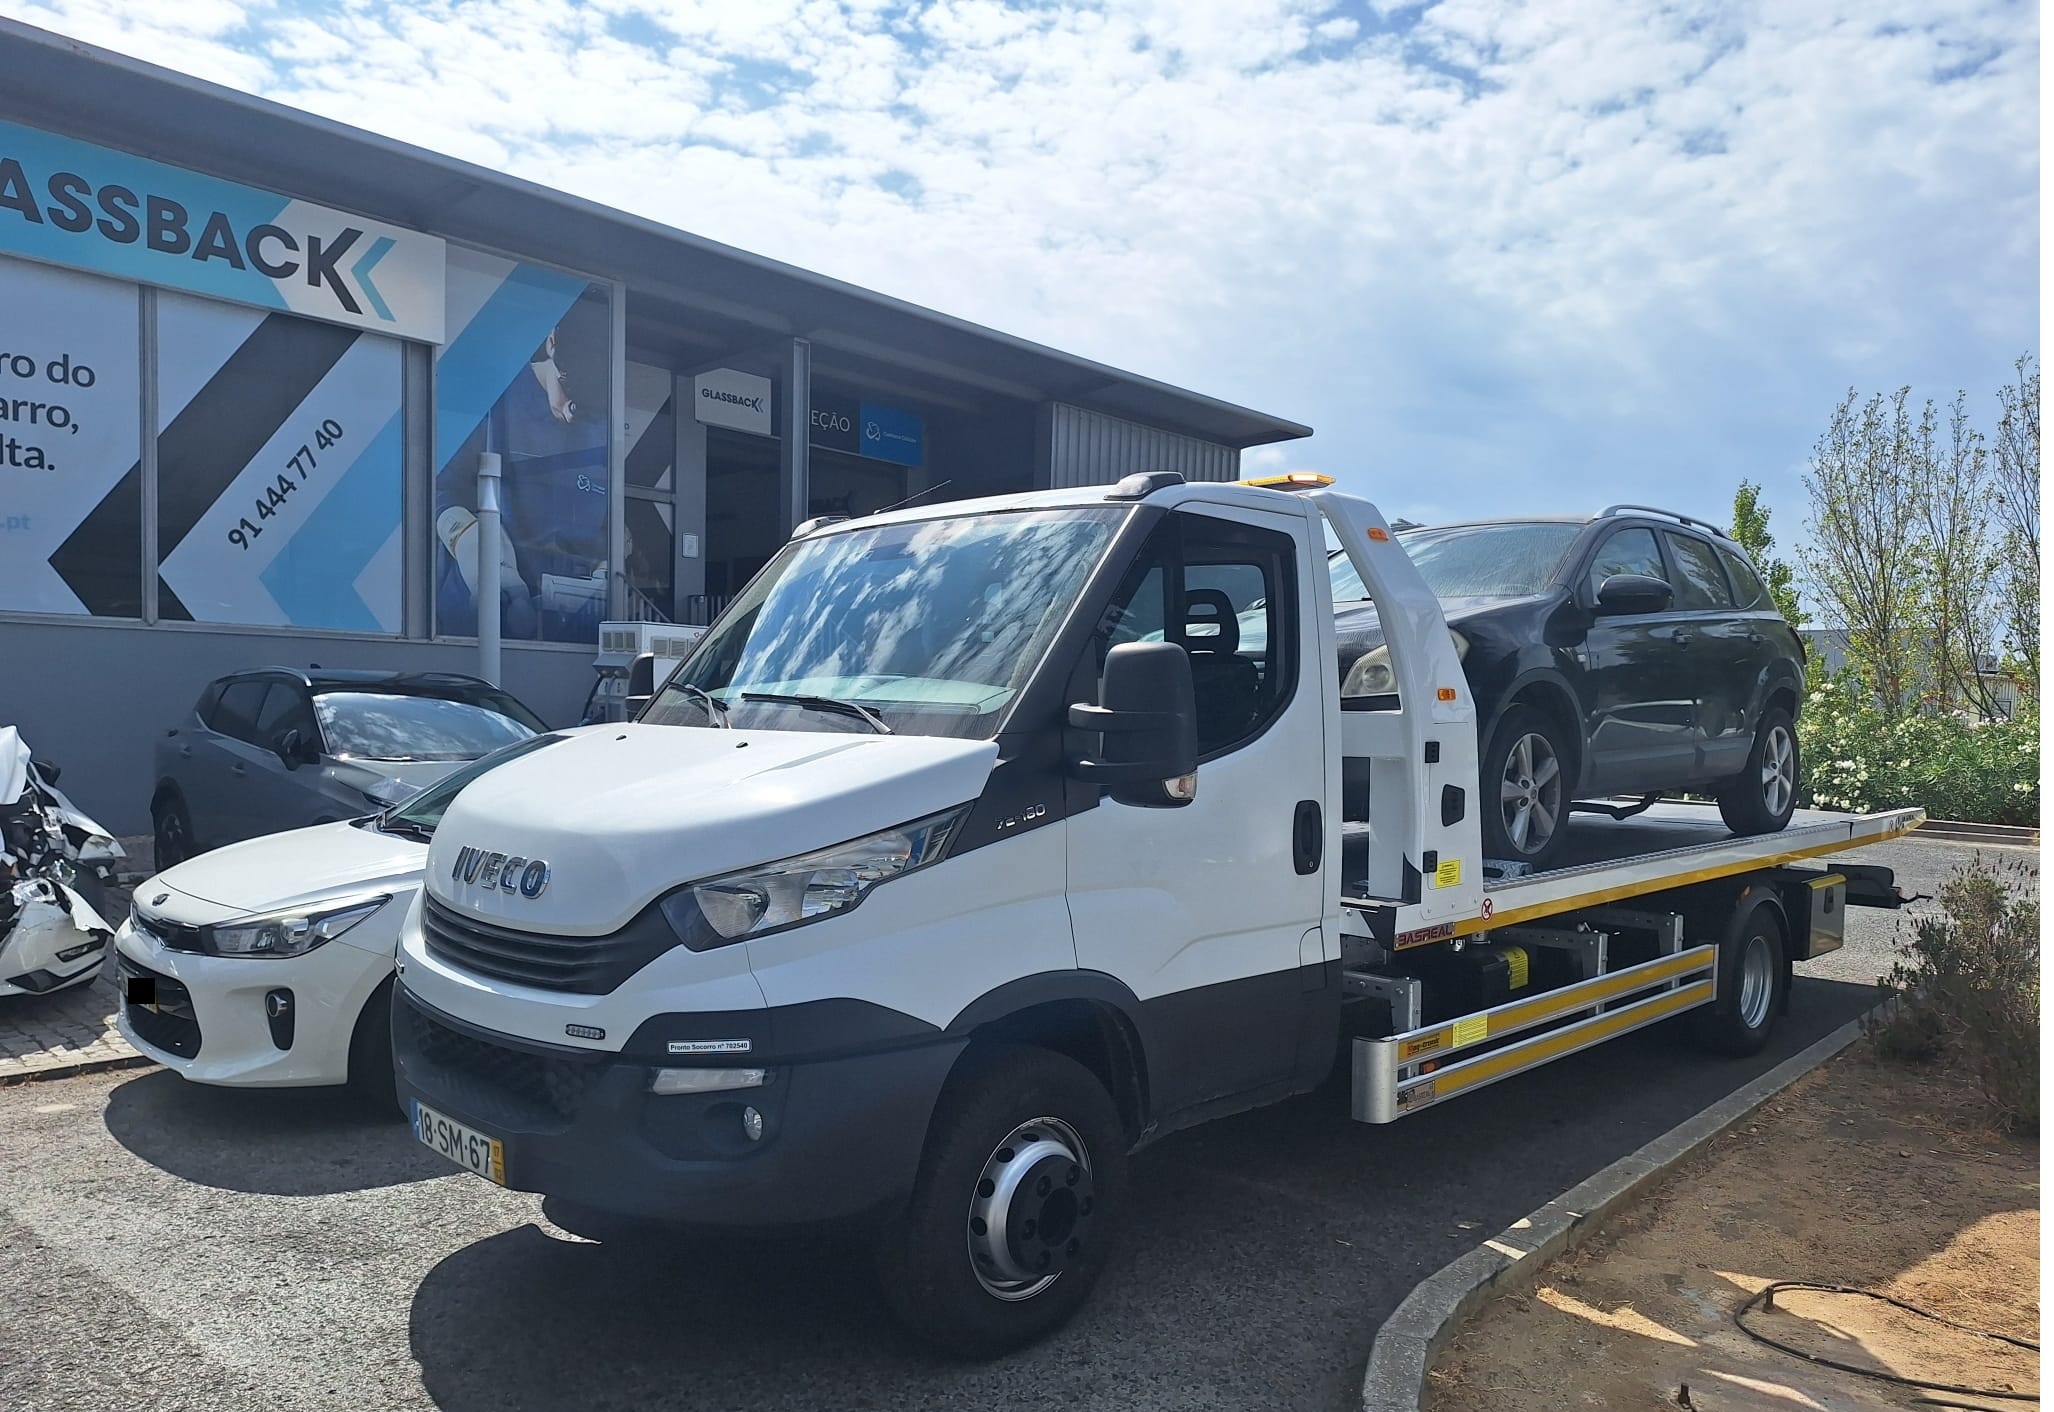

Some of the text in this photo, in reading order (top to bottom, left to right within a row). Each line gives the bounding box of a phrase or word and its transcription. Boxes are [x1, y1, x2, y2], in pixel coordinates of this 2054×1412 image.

[46, 353, 96, 388] do
[701, 388, 760, 413] GLASSBACK
[228, 419, 344, 551] 91 444 77 40
[452, 845, 552, 900] IVECO
[670, 1044, 691, 1052] Pronto
[692, 1043, 716, 1051] Socorro
